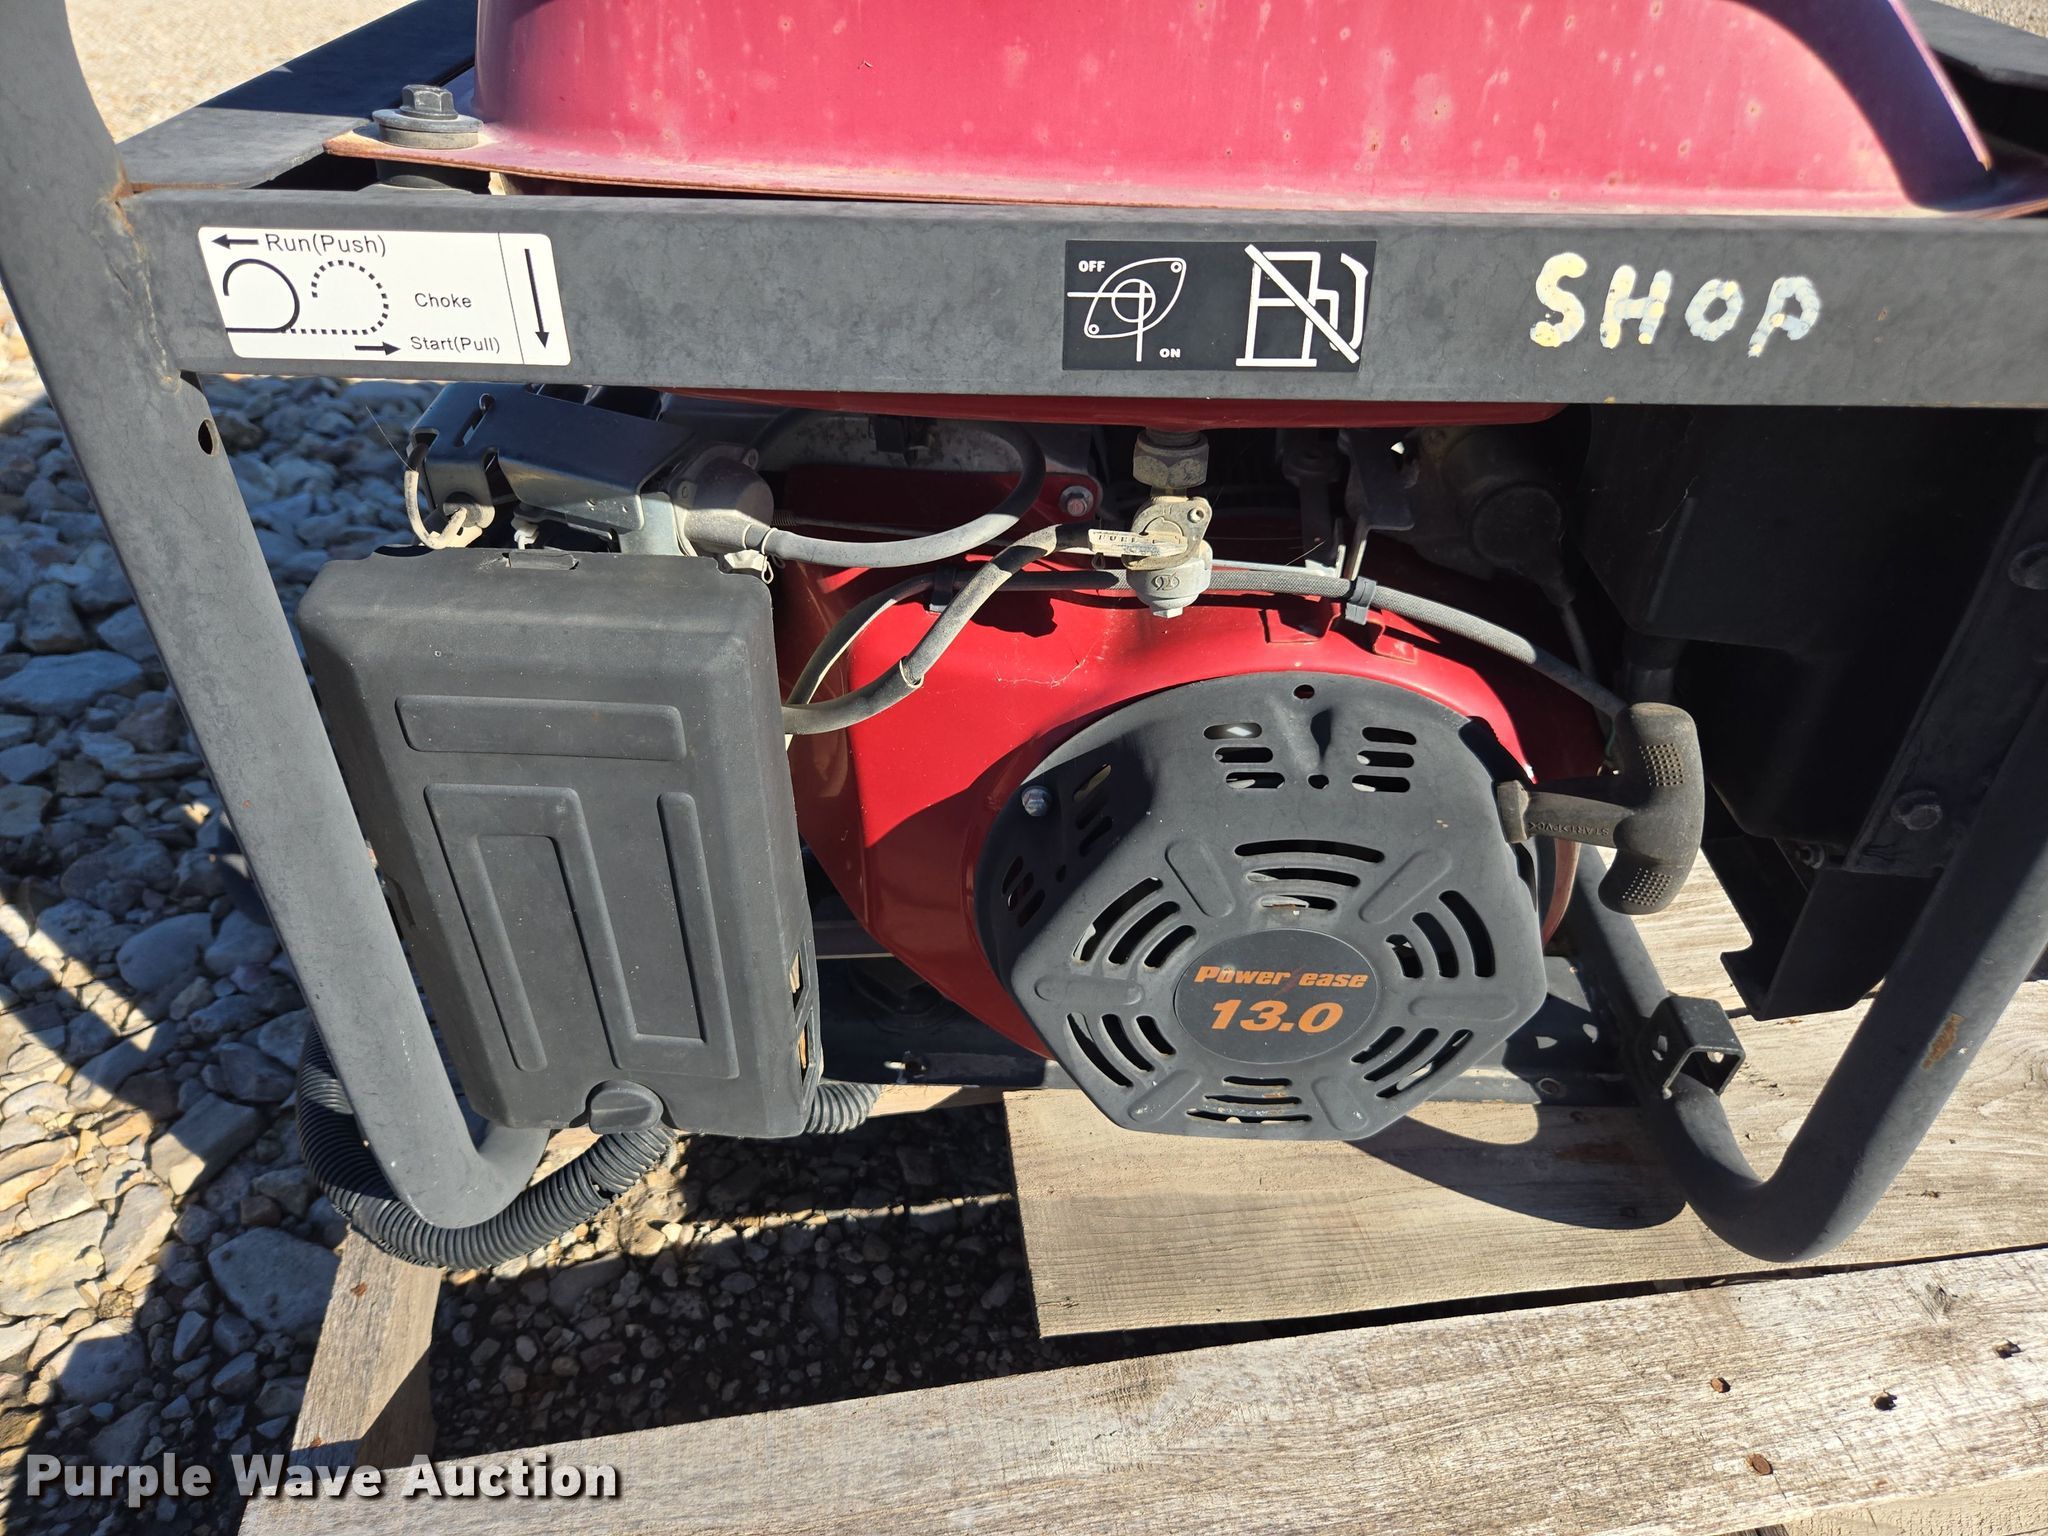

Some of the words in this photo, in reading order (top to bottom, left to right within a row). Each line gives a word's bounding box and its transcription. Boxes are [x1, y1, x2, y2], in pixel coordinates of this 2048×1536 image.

[265, 232, 387, 257] Run(Push)
[1078, 259, 1106, 273] OFF
[413, 292, 472, 308] Choke
[1529, 251, 1822, 358] SHOP
[410, 336, 501, 354] Start(Pull)
[1159, 348, 1181, 358] ON
[1194, 965, 1291, 985] Power
[1298, 972, 1369, 988] ease
[1211, 999, 1344, 1033] 13.0
